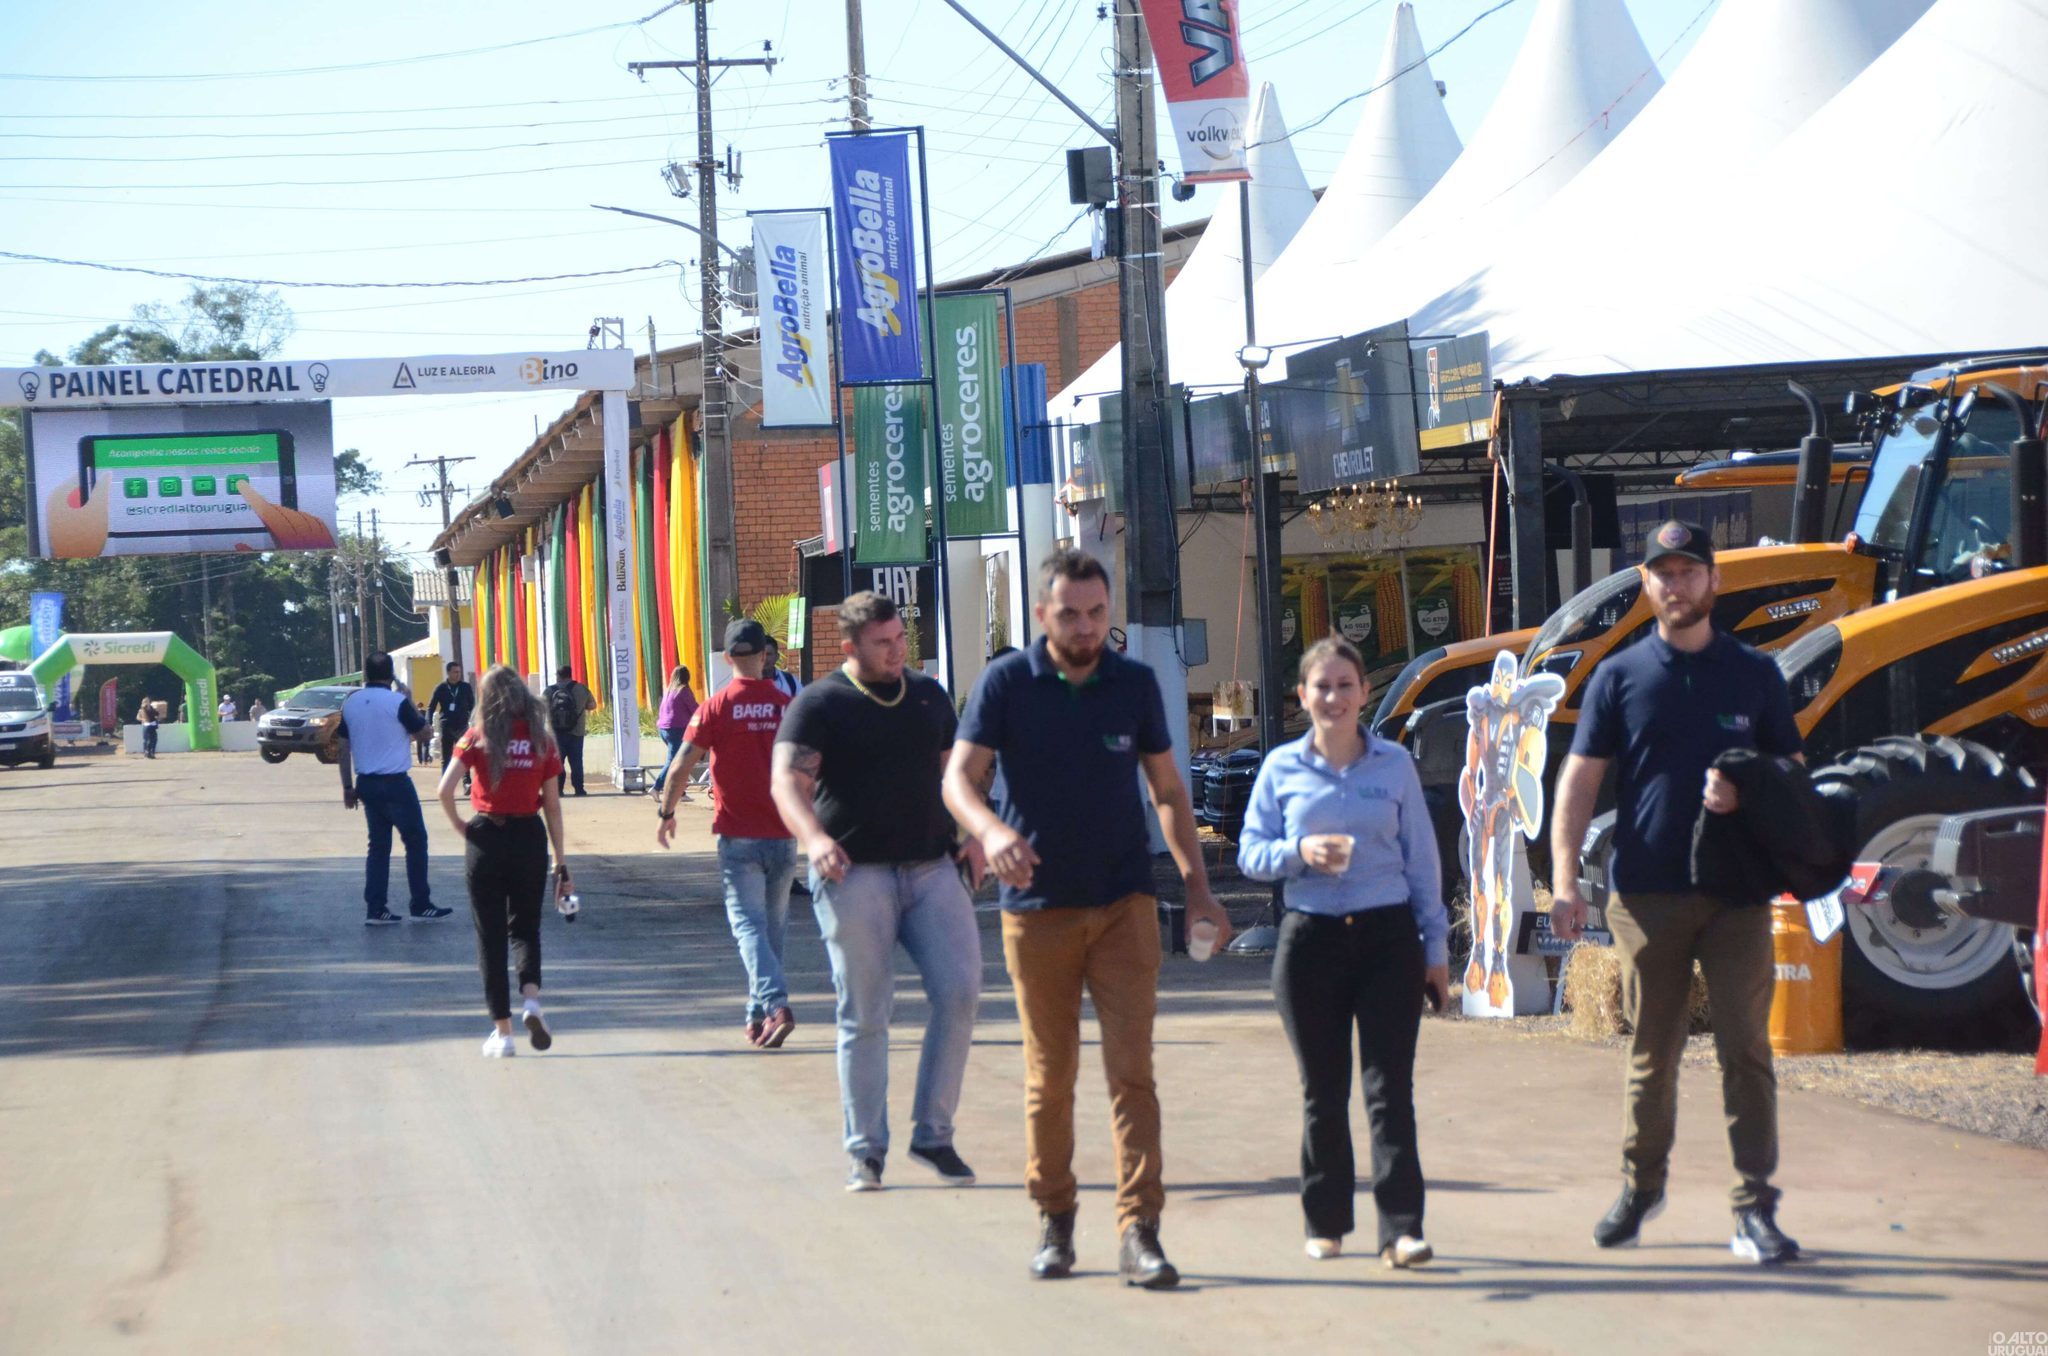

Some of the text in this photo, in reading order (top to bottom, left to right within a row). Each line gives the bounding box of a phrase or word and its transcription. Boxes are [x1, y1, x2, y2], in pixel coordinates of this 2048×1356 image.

[882, 176, 899, 270] nutrição animal
[849, 169, 897, 334] AgroBella
[798, 251, 812, 330] nutrição animal
[769, 244, 809, 384] AgroBella
[50, 366, 300, 398] PAINEL CATEDRAL
[417, 365, 496, 377] LUZ E ALEGRIA
[520, 357, 579, 384] Bino
[956, 325, 993, 502] agroceres
[943, 423, 957, 502] sementes
[1333, 446, 1374, 479] CHEVROLET
[867, 461, 881, 532] sementes
[872, 567, 919, 605] FIAT
[1766, 598, 1822, 619] VALTRA
[104, 641, 155, 655] Sicredi
[617, 648, 629, 675] URI
[196, 678, 210, 717] Sicredi
[506, 739, 531, 755] RR
[1775, 964, 1812, 980] TRA
